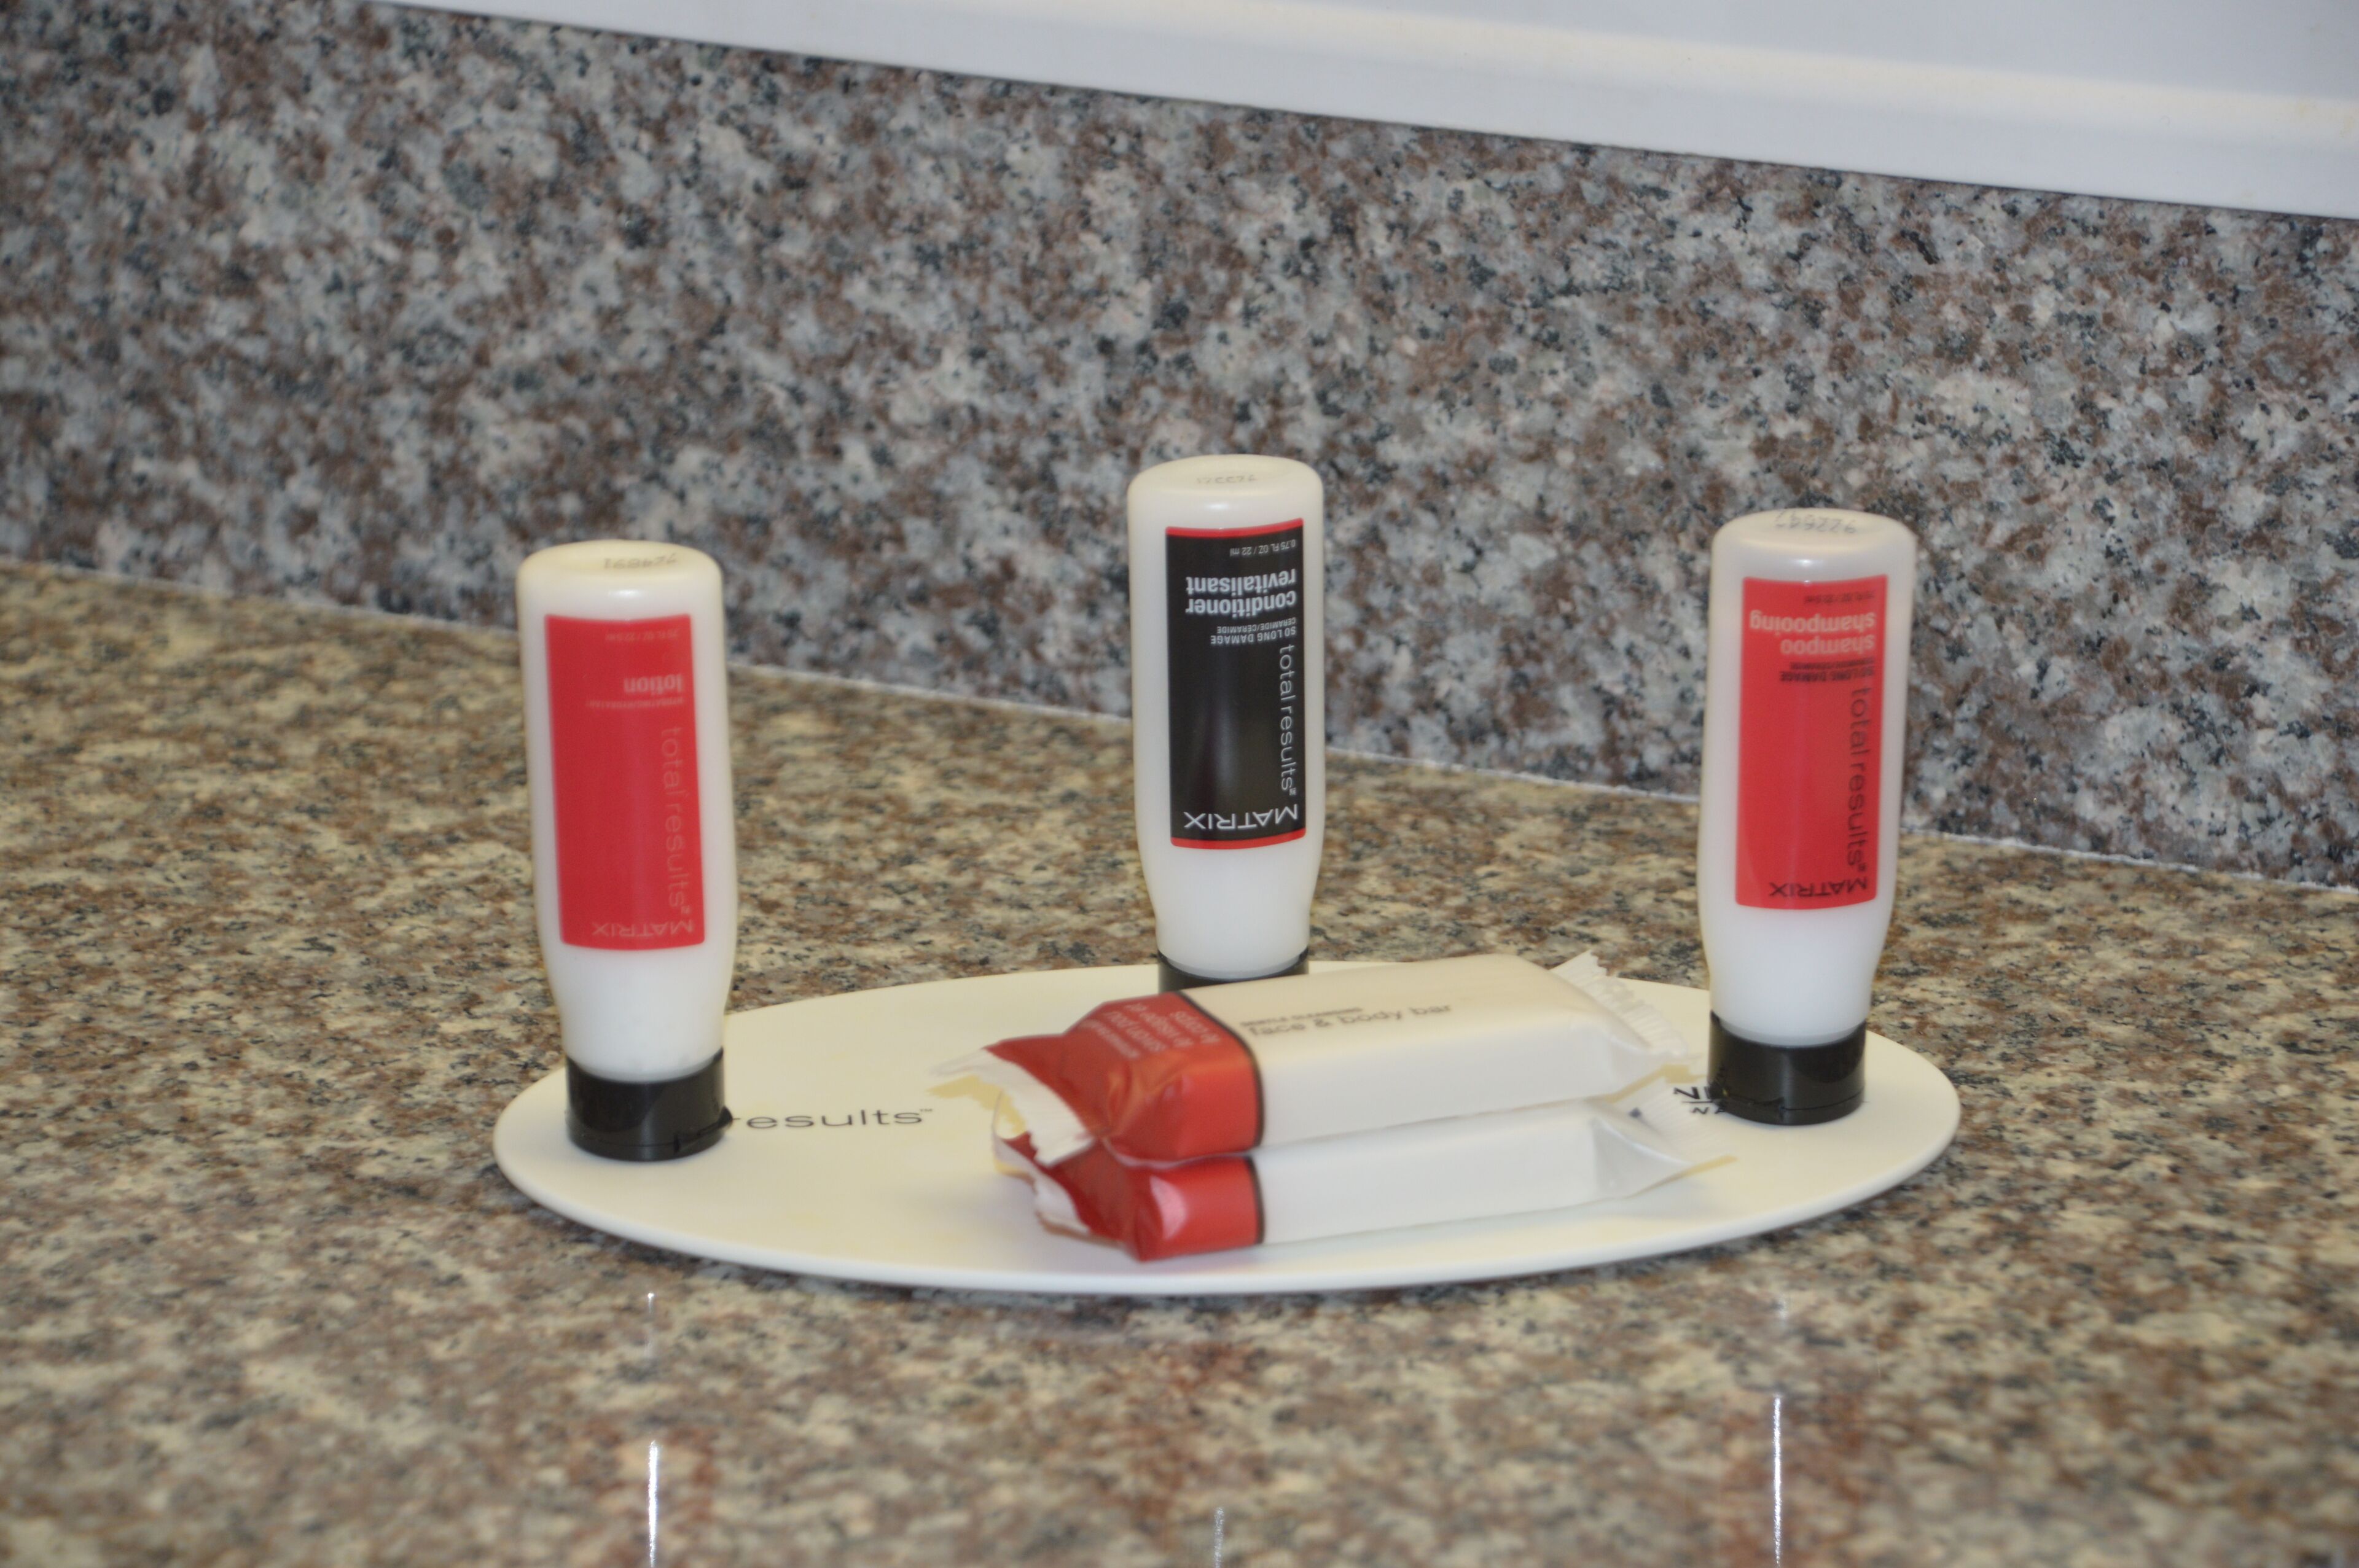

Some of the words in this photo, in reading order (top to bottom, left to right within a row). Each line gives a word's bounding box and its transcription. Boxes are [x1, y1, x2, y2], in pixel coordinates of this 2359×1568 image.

[1230, 548, 1239, 557] ml
[1242, 547, 1252, 556] 22
[1258, 544, 1269, 555] OZ
[1270, 543, 1279, 552] FL
[1280, 539, 1296, 550] 0.75
[1186, 569, 1296, 599] revitalisant
[1186, 590, 1296, 619] conditioner
[1285, 626, 1296, 637] SO
[1750, 609, 1876, 636] shampooing
[1210, 634, 1254, 644] DAMAGE
[1257, 630, 1283, 642] LONG
[1780, 634, 1876, 655] shampoo
[624, 673, 683, 697] lotion
[1184, 803, 1298, 830] MATRIX
[1769, 877, 1868, 898] MATRIX
[591, 919, 694, 937] MATRIX
[1247, 1020, 1307, 1037] face
[1315, 1017, 1335, 1029] &
[1339, 1010, 1402, 1031] body
[1408, 1003, 1452, 1015] bar
